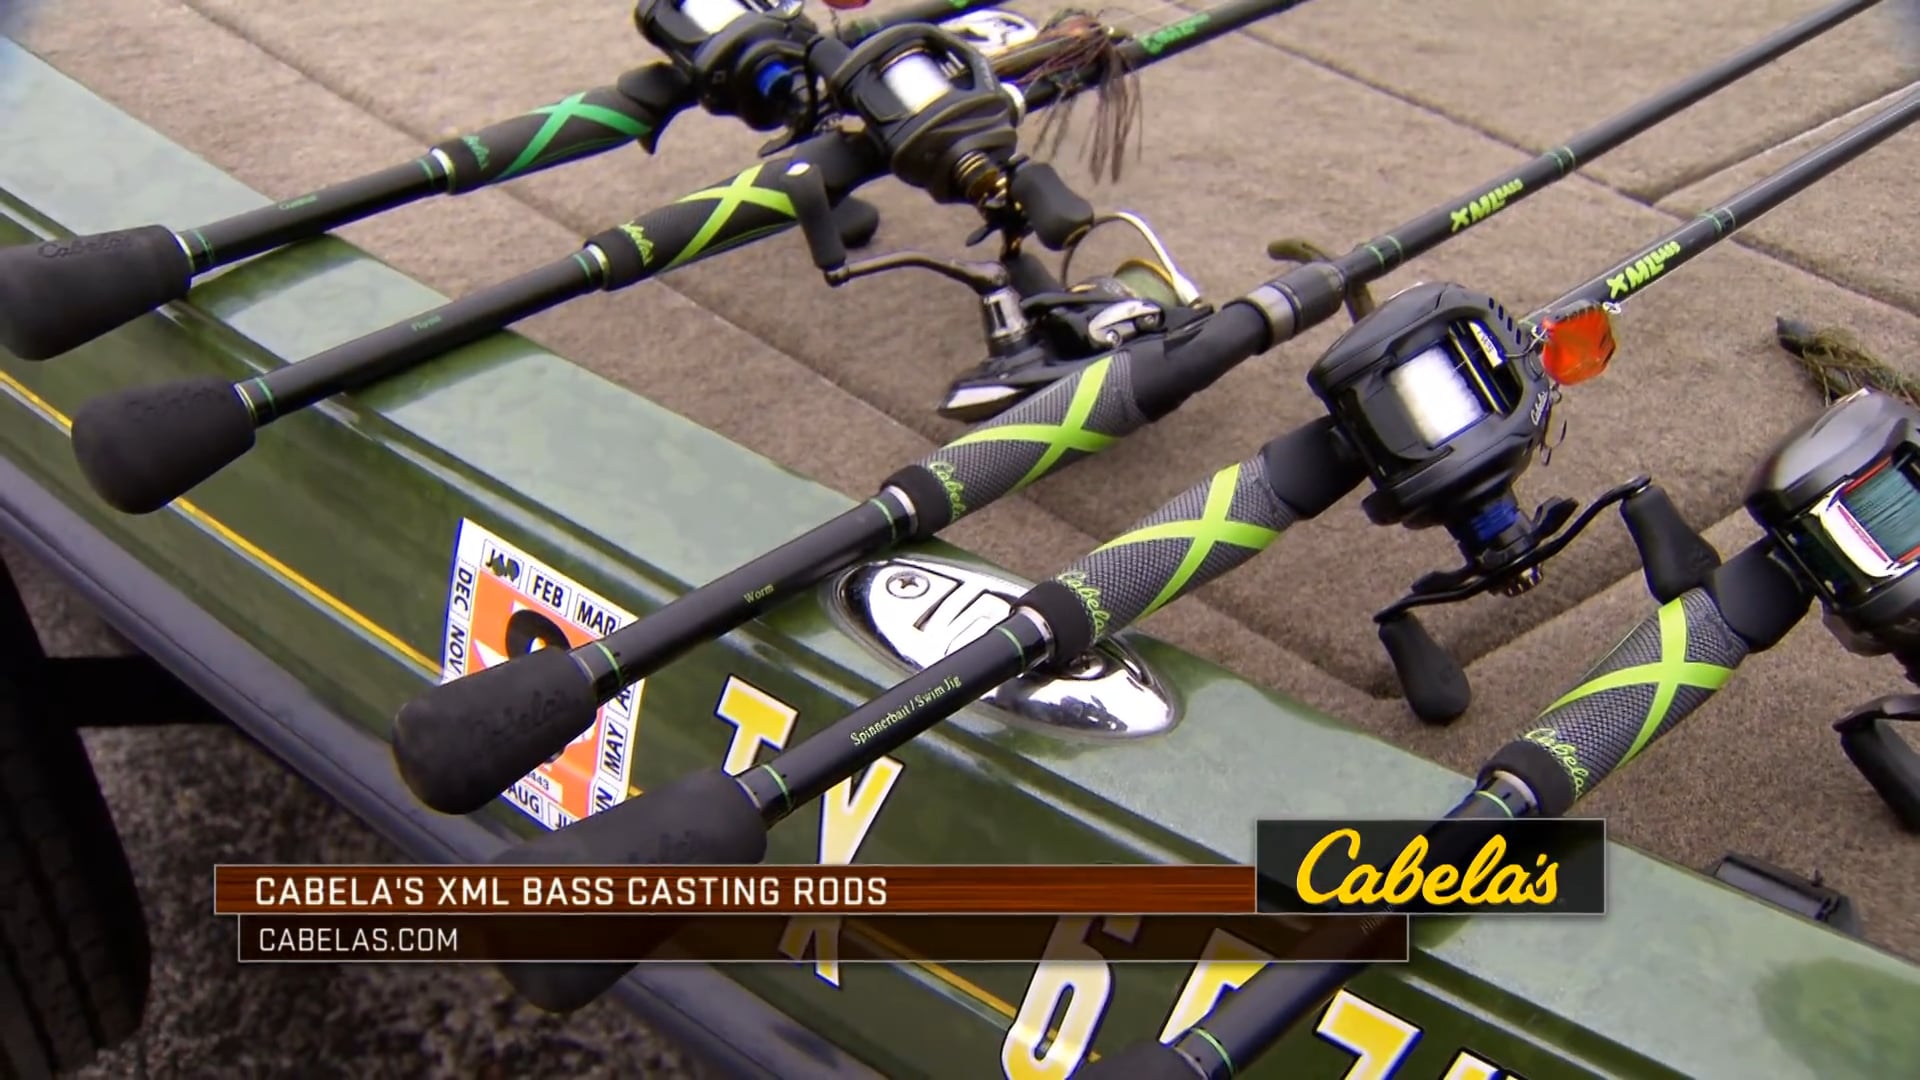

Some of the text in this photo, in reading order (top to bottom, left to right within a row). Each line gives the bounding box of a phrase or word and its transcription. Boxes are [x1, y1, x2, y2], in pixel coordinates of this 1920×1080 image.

[454, 567, 473, 611] DEC
[532, 575, 564, 608] FEB
[743, 583, 774, 604] Worm
[576, 601, 616, 635] MAR
[448, 625, 466, 675] NOV
[850, 705, 911, 746] Spinnerbait
[914, 686, 946, 707] Swim
[943, 675, 962, 691] Jig
[604, 722, 624, 775] MAY
[508, 783, 540, 814] AUG
